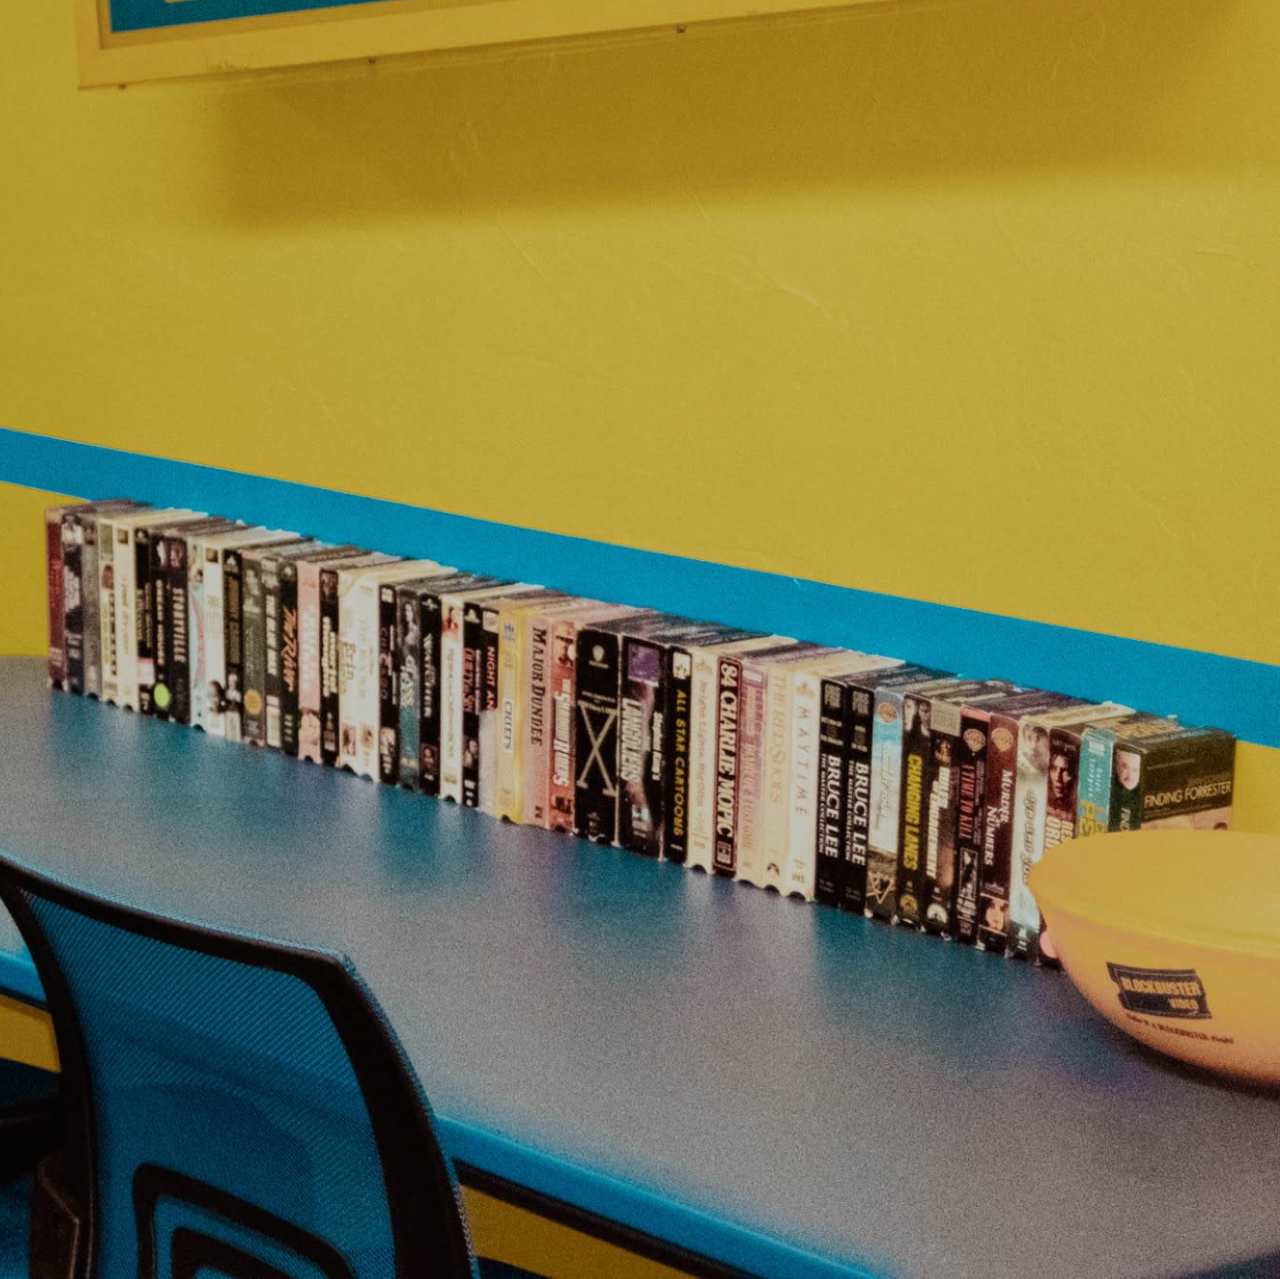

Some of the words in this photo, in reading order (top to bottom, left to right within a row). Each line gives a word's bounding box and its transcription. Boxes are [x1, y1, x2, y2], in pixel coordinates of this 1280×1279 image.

[173, 587, 187, 664] STORYVILLE
[487, 646, 496, 687] NIGHT
[532, 626, 547, 682] MAJOR
[721, 663, 738, 688] 84
[530, 682, 546, 746] DUNDEE
[677, 689, 687, 712] ALL
[620, 697, 643, 783] LANGOLIERS
[676, 718, 687, 752] STAR
[718, 691, 738, 774] CHARLIE
[795, 705, 809, 818] MAYTIME
[825, 754, 842, 821] BRUCE
[960, 771, 975, 797] TIME
[673, 756, 686, 837] CARTOONS
[716, 775, 735, 838] MOPIC
[853, 762, 870, 826] BRUCE
[904, 753, 923, 826] CHANGING
[999, 769, 1014, 823] MURDER
[1144, 790, 1184, 808] FINDING
[1184, 780, 1232, 801] FORRESTER
[817, 804, 825, 853] COLLECTION
[824, 824, 839, 859] LEE
[845, 811, 853, 861] COLLECTION
[851, 830, 868, 866] LEE
[903, 826, 921, 871] LANES
[958, 815, 973, 841] KILL
[984, 806, 997, 866] NUMBERS
[1120, 976, 1202, 996] BLOCKBUSTER
